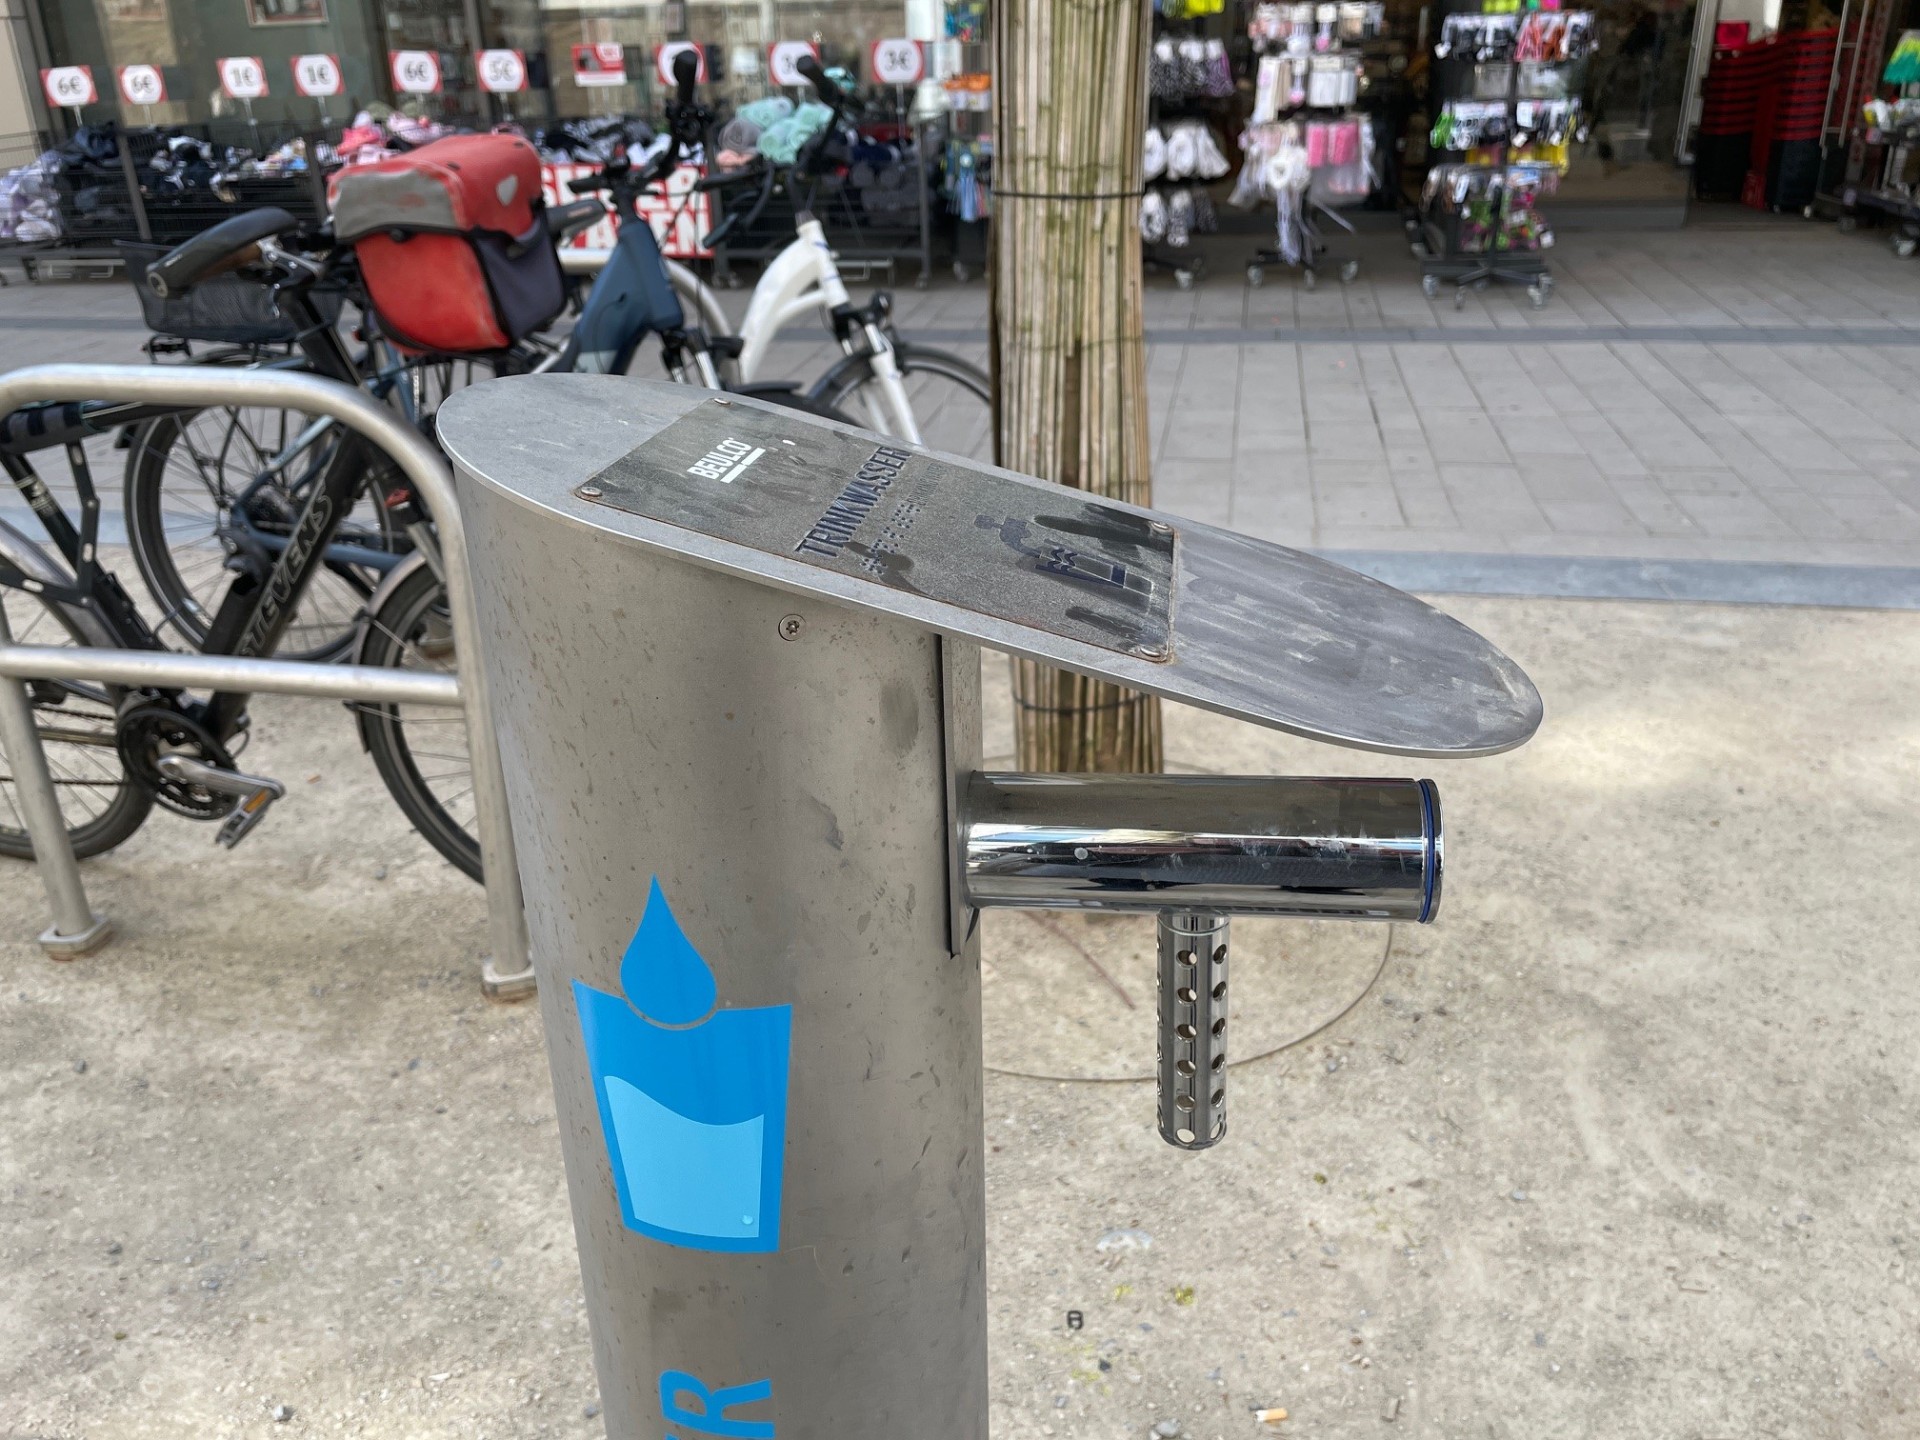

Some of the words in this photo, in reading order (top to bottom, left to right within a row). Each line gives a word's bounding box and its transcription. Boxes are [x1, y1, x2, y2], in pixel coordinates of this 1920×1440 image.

[58, 75, 82, 95] 6€
[231, 66, 256, 86] 1€
[307, 64, 331, 85] 1€
[687, 438, 752, 480] BEULCO
[795, 446, 912, 558] TRINKWASSER
[657, 1368, 776, 1440] R
